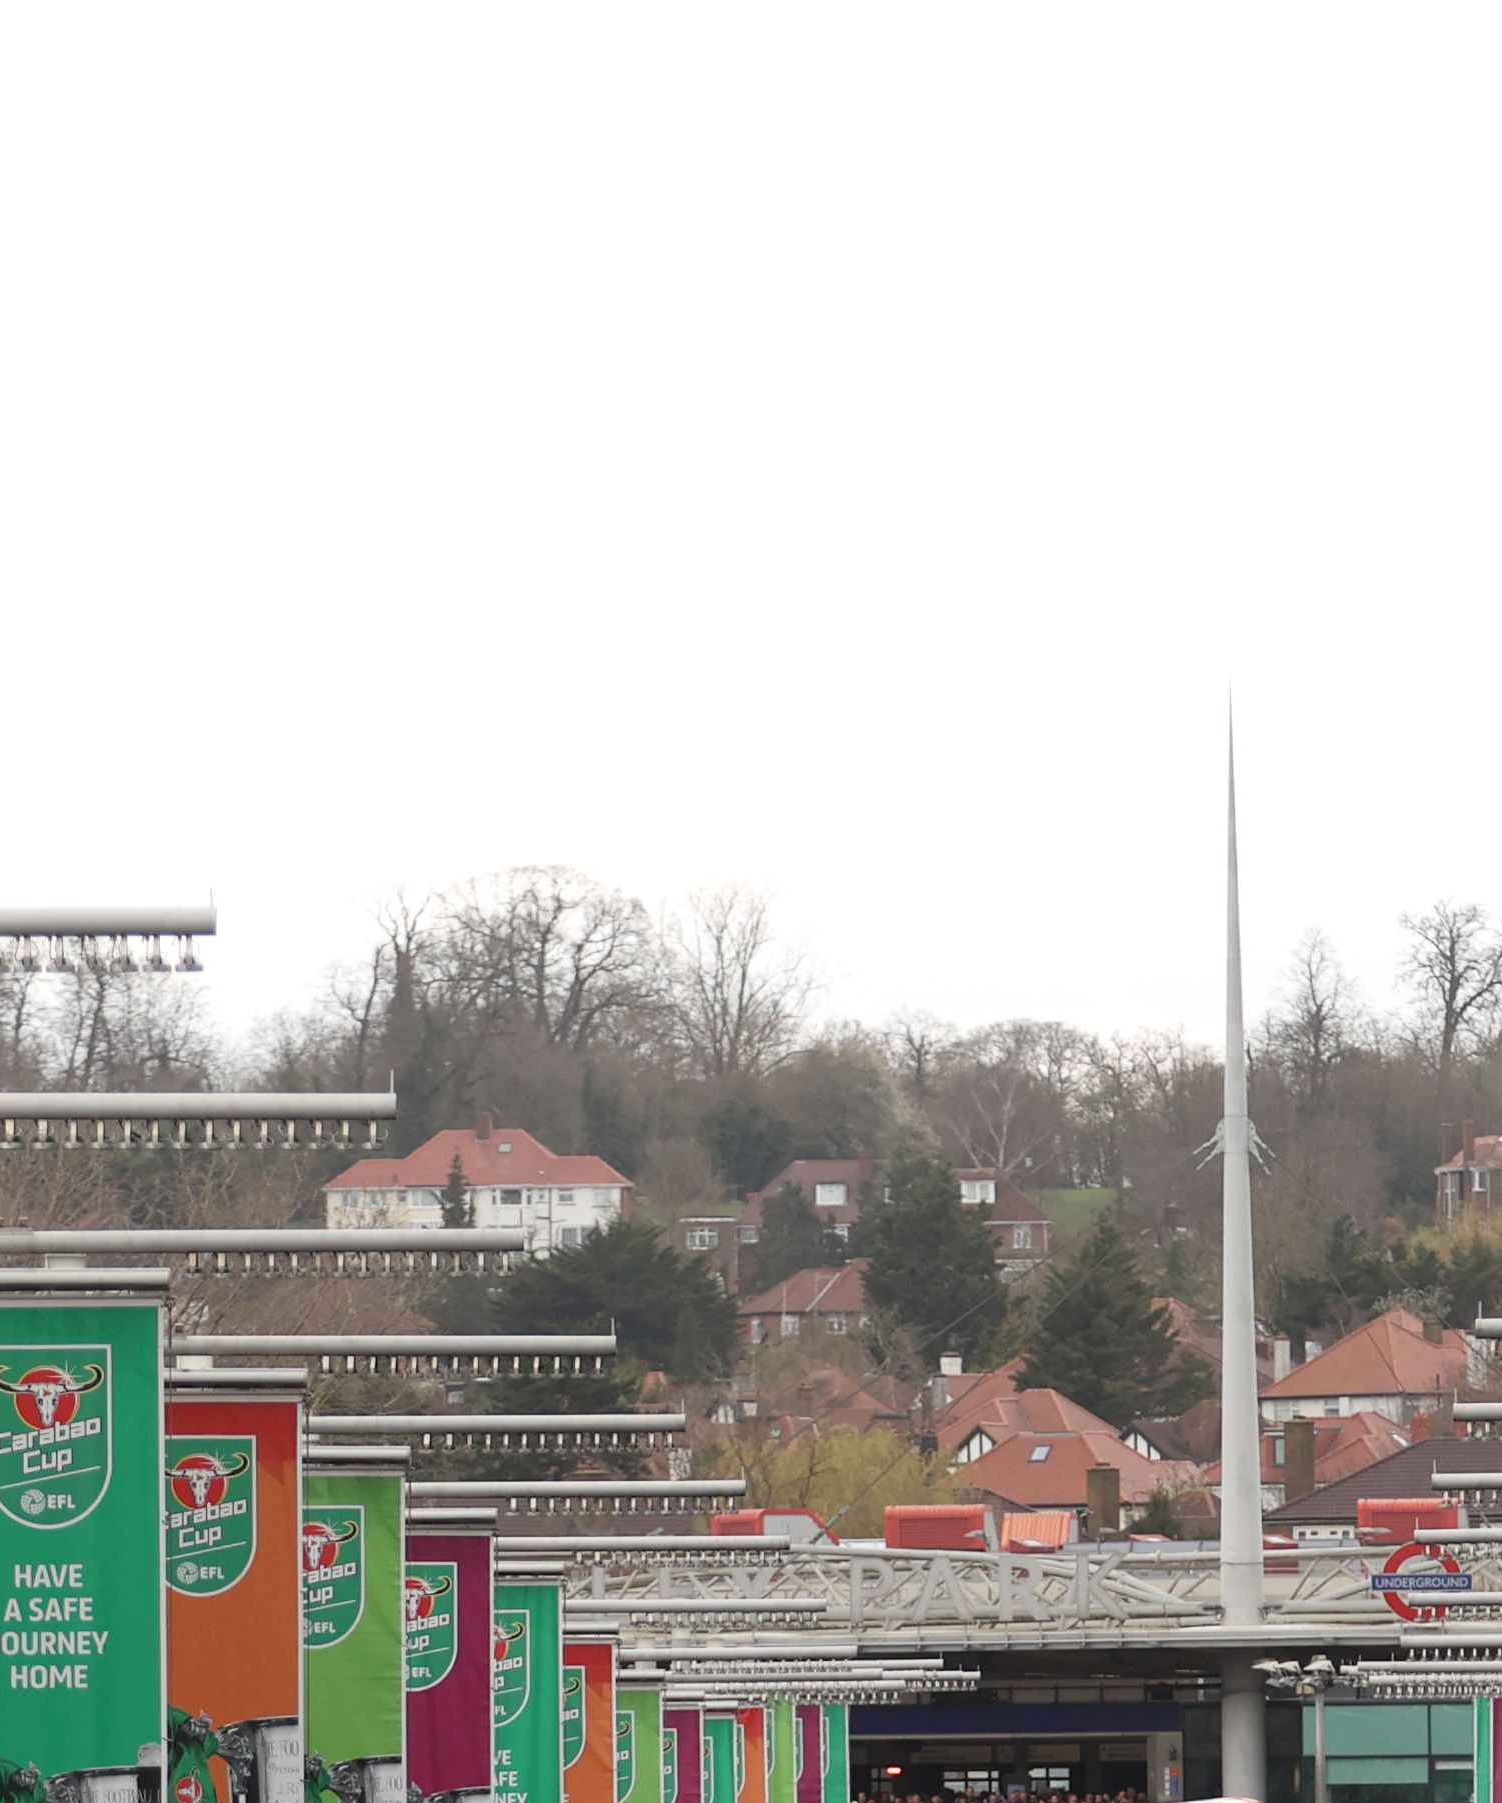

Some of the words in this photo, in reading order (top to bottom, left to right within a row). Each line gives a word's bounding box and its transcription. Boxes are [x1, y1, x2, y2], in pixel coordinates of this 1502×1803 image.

[22, 1447, 72, 1475] Cup
[47, 1494, 76, 1510] EFL
[164, 1499, 247, 1530] arabao
[178, 1525, 222, 1549] Cup
[14, 1563, 83, 1588] HAVE
[200, 1566, 225, 1580] EFL
[1374, 1575, 1471, 1590] UNDERGROUND
[4, 1598, 23, 1621] A
[29, 1597, 94, 1622] SAFE
[313, 1621, 336, 1634] EFL
[10, 1664, 89, 1689] HOME
[411, 1667, 432, 1678] EFL
